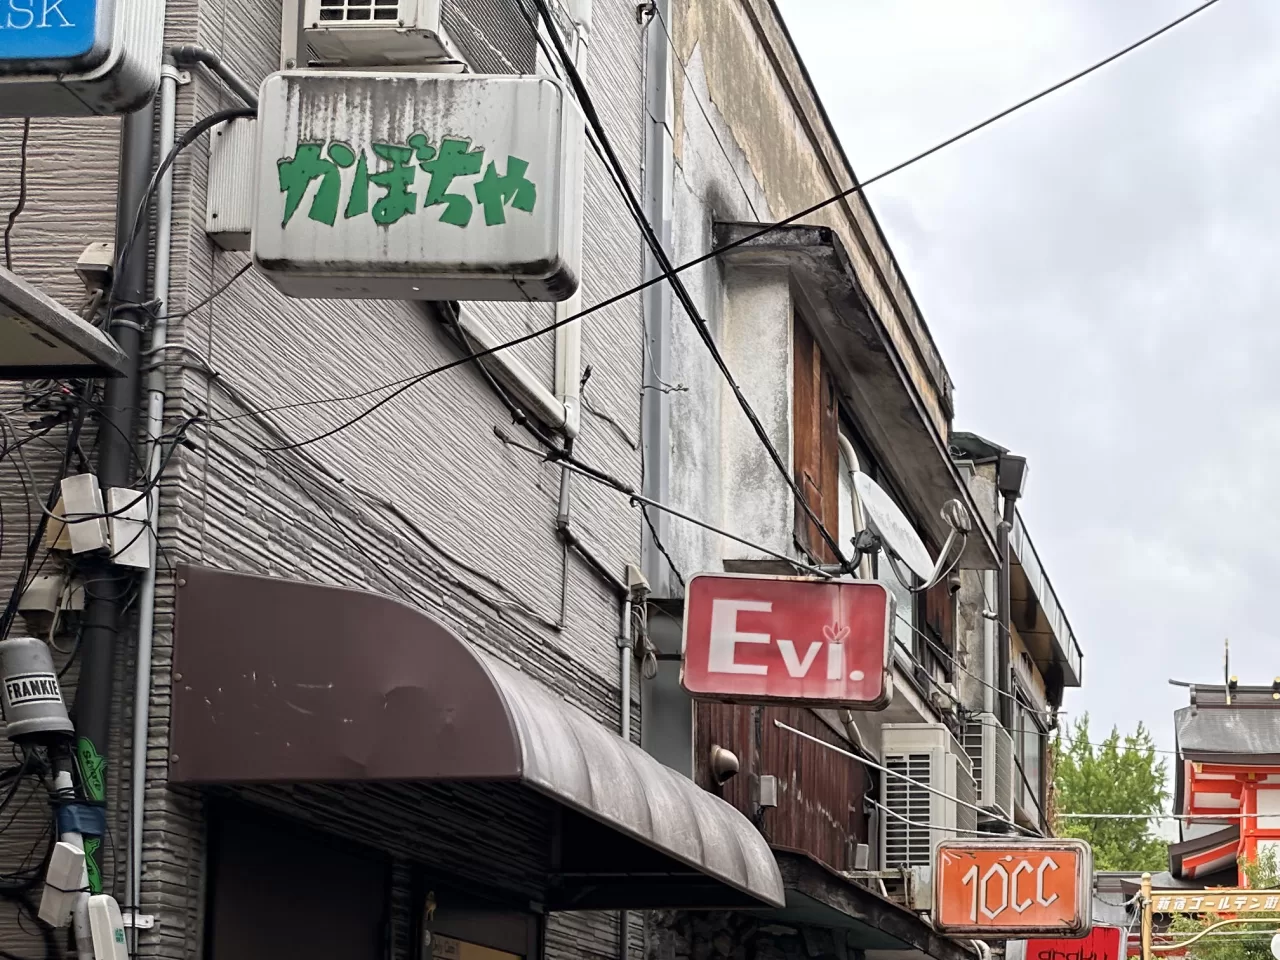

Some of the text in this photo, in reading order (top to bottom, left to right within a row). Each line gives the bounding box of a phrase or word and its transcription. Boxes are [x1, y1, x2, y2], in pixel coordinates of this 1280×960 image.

[0, 0, 76, 29] SK
[7, 679, 60, 700] FRANKIE
[1157, 896, 1280, 911] 新宿ゴールデン街
